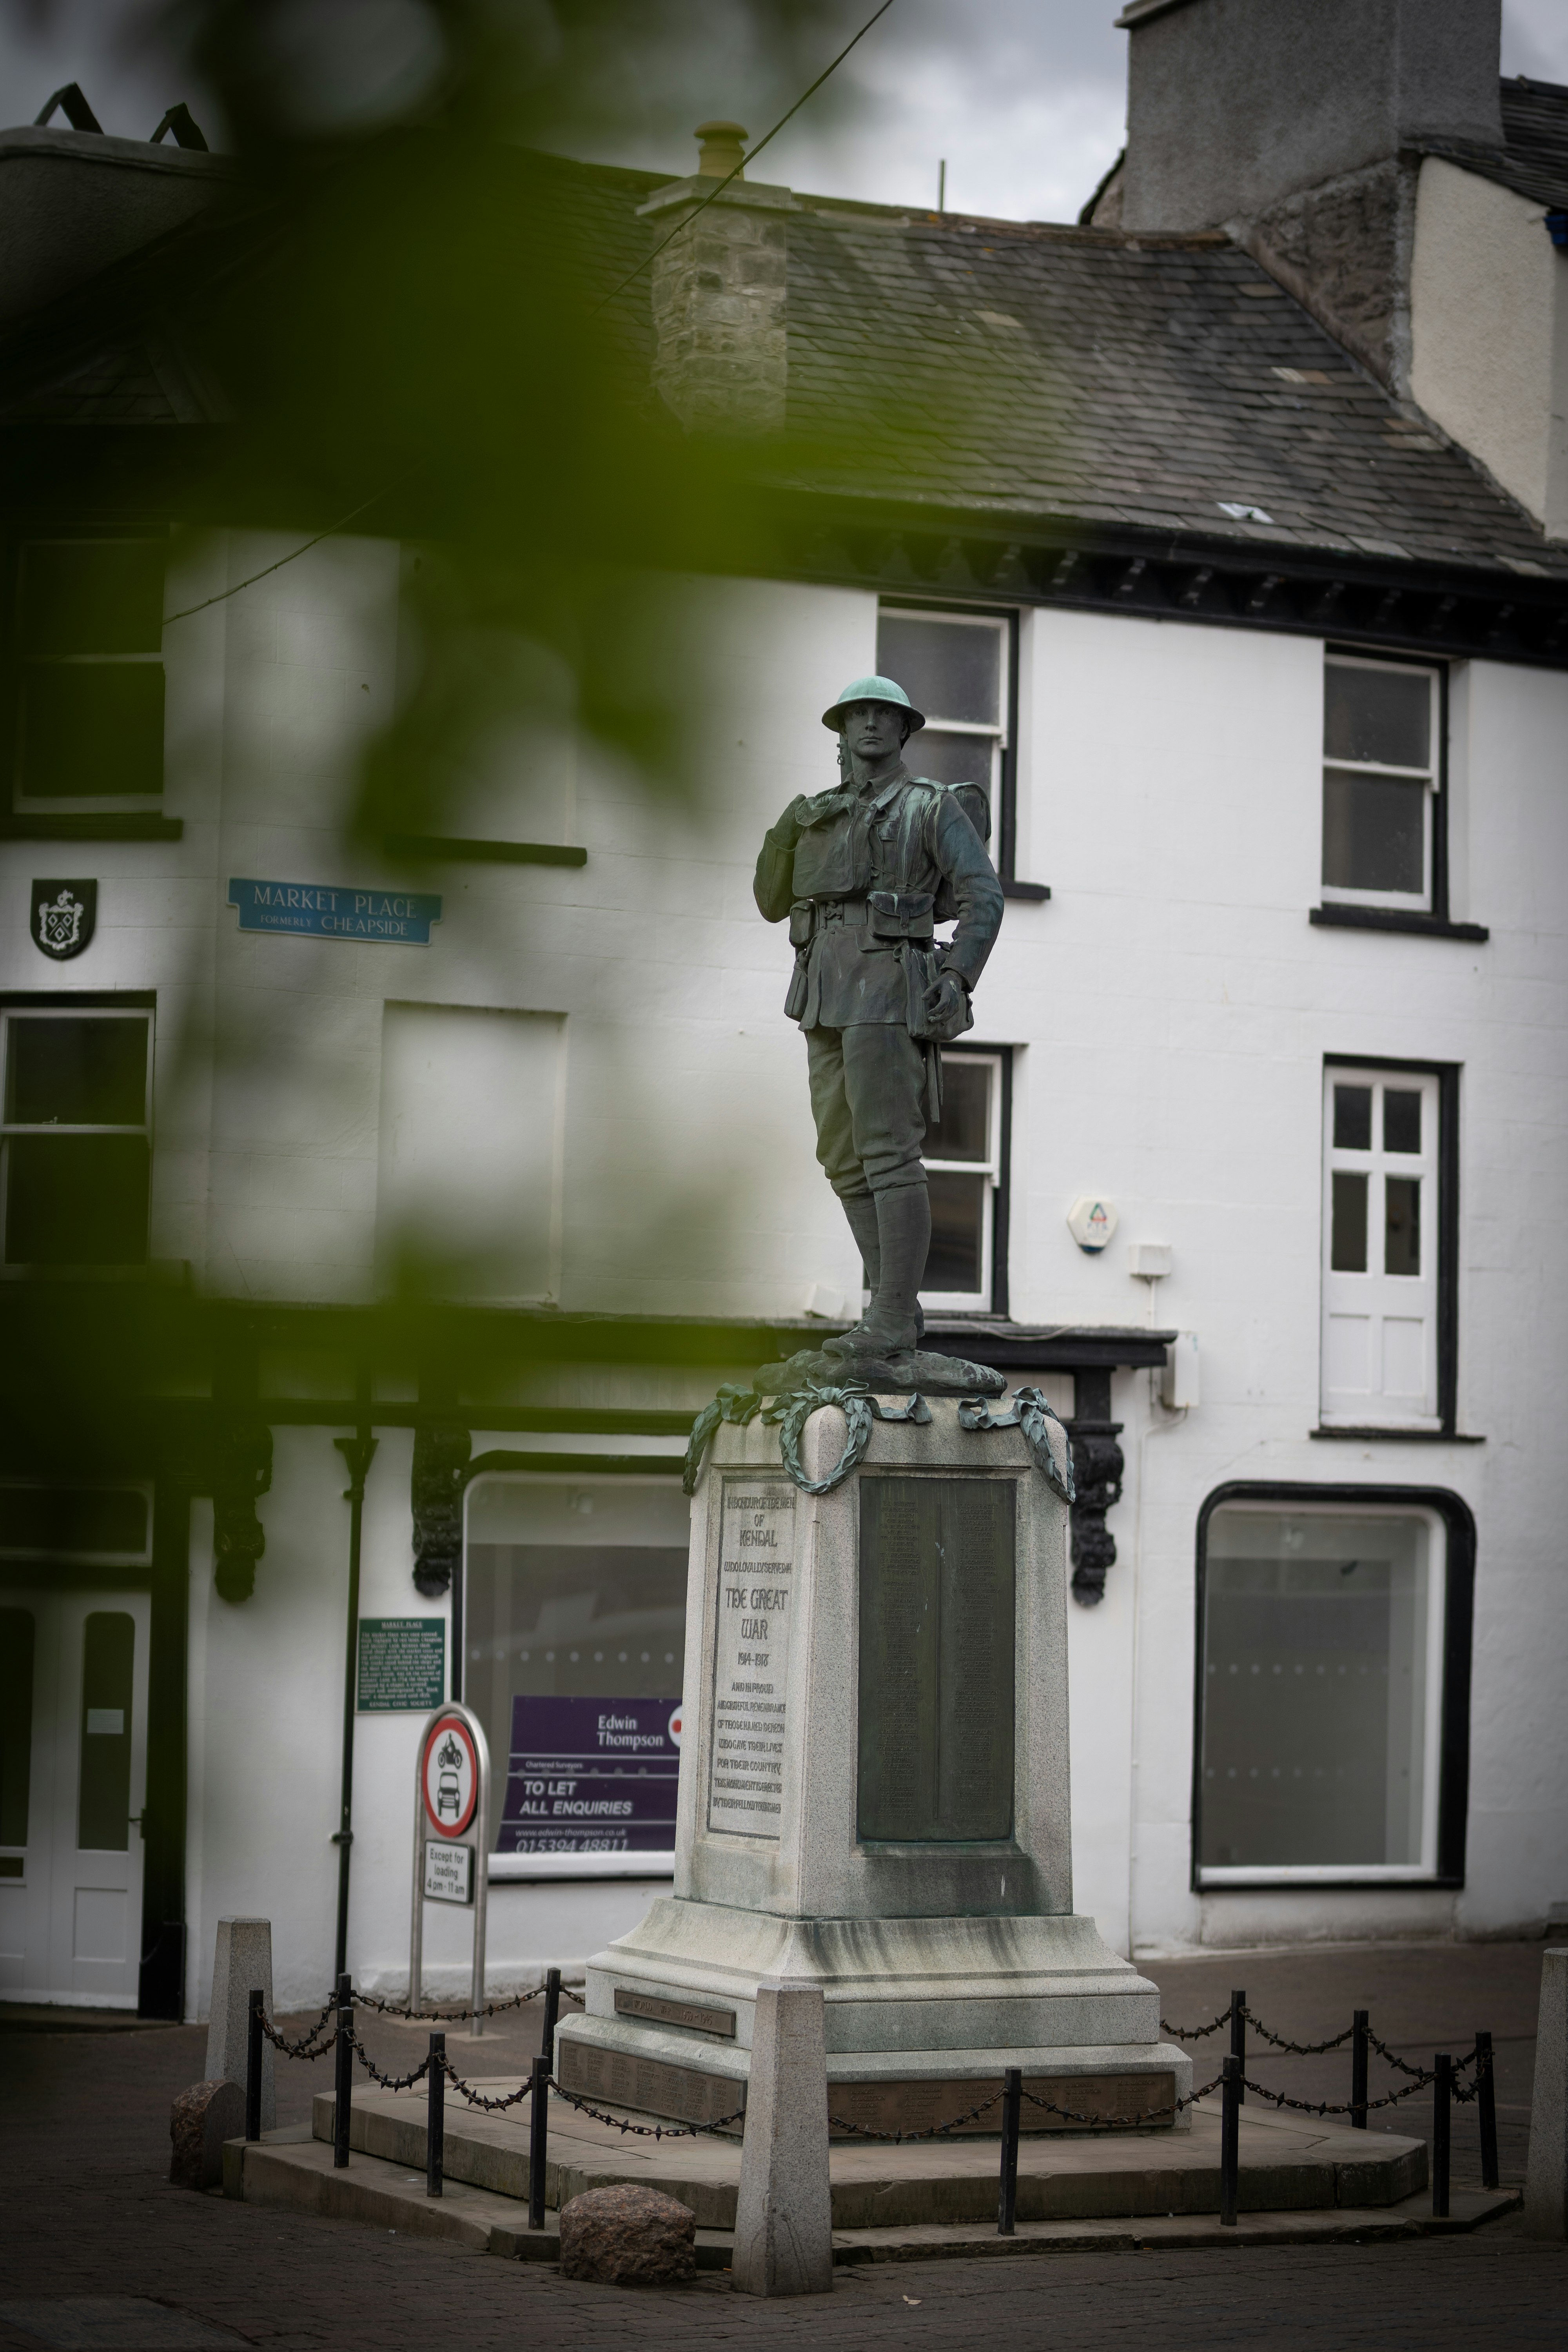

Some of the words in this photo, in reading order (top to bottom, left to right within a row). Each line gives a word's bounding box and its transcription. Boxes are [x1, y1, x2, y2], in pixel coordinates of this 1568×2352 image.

[254, 886, 338, 912] MARKET
[355, 895, 417, 918] PLACE
[261, 914, 312, 927] FORMERLY
[321, 916, 408, 936] CHEAPSIDE
[754, 1514, 764, 1526] OF
[739, 1530, 777, 1546] KENDAL
[725, 1588, 747, 1608] THE
[750, 1588, 788, 1610] GREAT
[741, 1618, 768, 1640] WAR
[731, 1682, 744, 1691] AND
[752, 1683, 773, 1693] PROUD
[598, 1715, 637, 1730] Edwin
[717, 1719, 724, 1728] OF
[724, 1720, 743, 1730] THOSE
[743, 1720, 762, 1731] NAMED
[597, 1731, 664, 1751] Thompson
[733, 1739, 746, 1750] GAVE
[748, 1740, 765, 1752] THEIR
[766, 1742, 782, 1753] LIVES
[717, 1758, 728, 1768] FOR
[729, 1759, 749, 1770] THEIR
[524, 1780, 544, 1795] TO
[548, 1781, 577, 1795] LET
[519, 1800, 549, 1815] ALL
[552, 1800, 633, 1815] ENQUIRIES
[515, 1828, 626, 1837] www.edwin-thompson.co.uk
[516, 1839, 576, 1853] 015394
[579, 1839, 628, 1852] 48811
[430, 1848, 452, 1863] Except
[454, 1852, 463, 1864] for
[434, 1864, 458, 1880] loading
[427, 1878, 432, 1888] 4
[433, 1882, 443, 1891] pm
[448, 1881, 453, 1893] 11
[455, 1885, 465, 1895] am
[633, 2000, 653, 2011] WORLD
[660, 2005, 671, 2016] WAR
[681, 2009, 693, 2021] 1939
[700, 2012, 712, 2025] 1945
